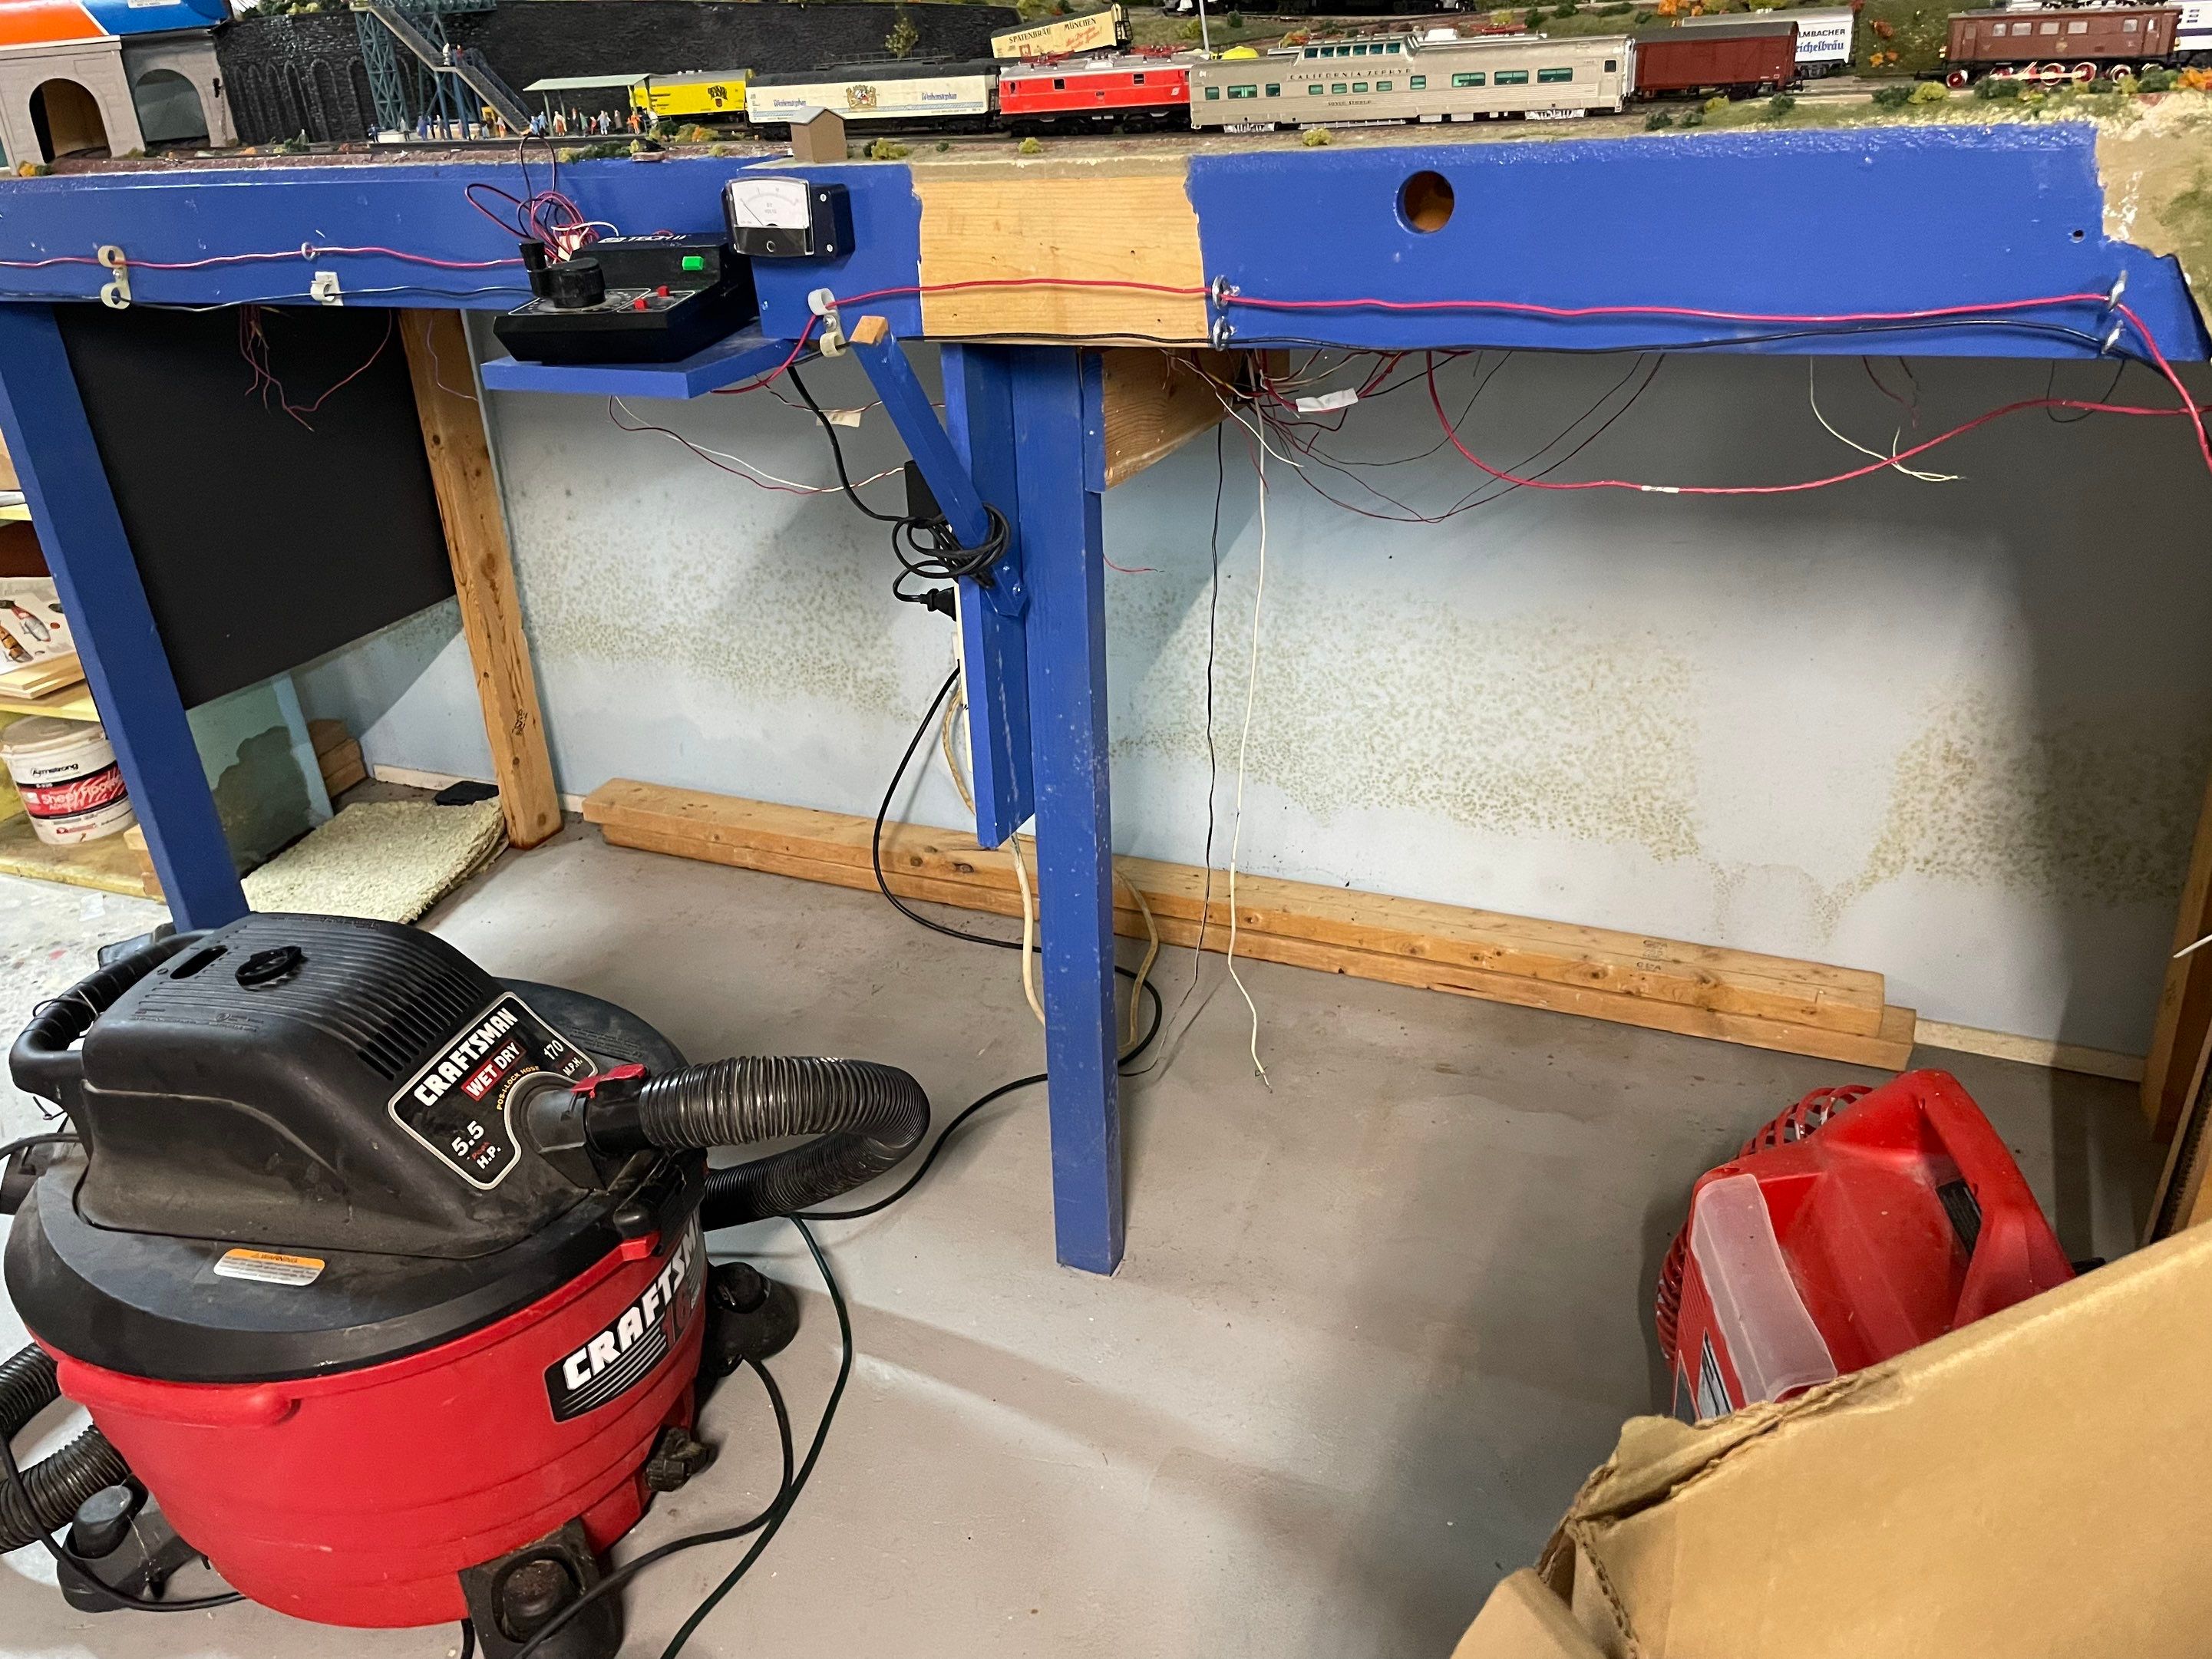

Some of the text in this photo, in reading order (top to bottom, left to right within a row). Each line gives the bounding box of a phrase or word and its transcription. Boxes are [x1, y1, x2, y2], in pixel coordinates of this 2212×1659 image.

[1798, 28, 1846, 38] LMBACHER
[1796, 39, 1844, 54] ichelbräu
[1290, 71, 1361, 80] CALIFORNIA
[31, 763, 79, 777] Armstrong
[414, 1008, 519, 1107] CRAFTSMAN
[543, 1039, 565, 1060] 170
[466, 1064, 499, 1097] WET
[494, 1041, 520, 1070] DRY
[451, 1120, 485, 1156] 5.5
[476, 1145, 502, 1169] H.P.
[563, 1207, 700, 1390] CRAFTSM
